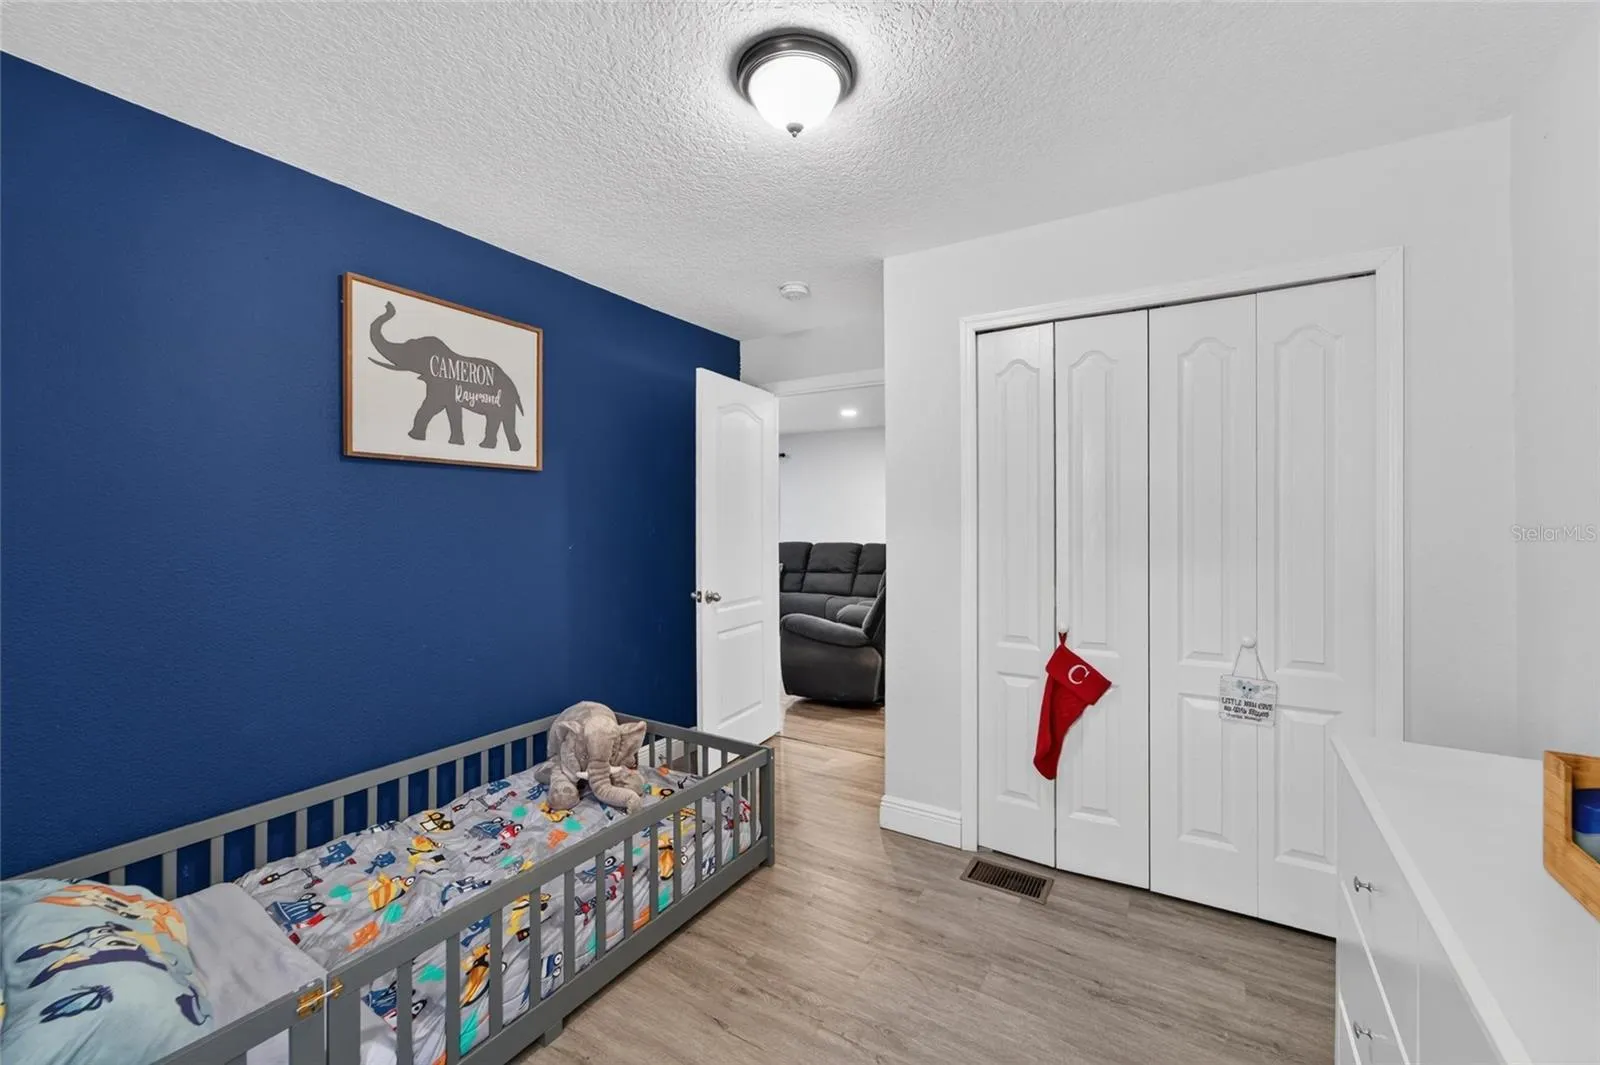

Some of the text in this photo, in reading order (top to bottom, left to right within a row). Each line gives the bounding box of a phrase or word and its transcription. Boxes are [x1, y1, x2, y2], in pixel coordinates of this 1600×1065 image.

[429, 354, 495, 387] CAMERON
[455, 383, 502, 408] Raymond
[1067, 664, 1090, 685] C
